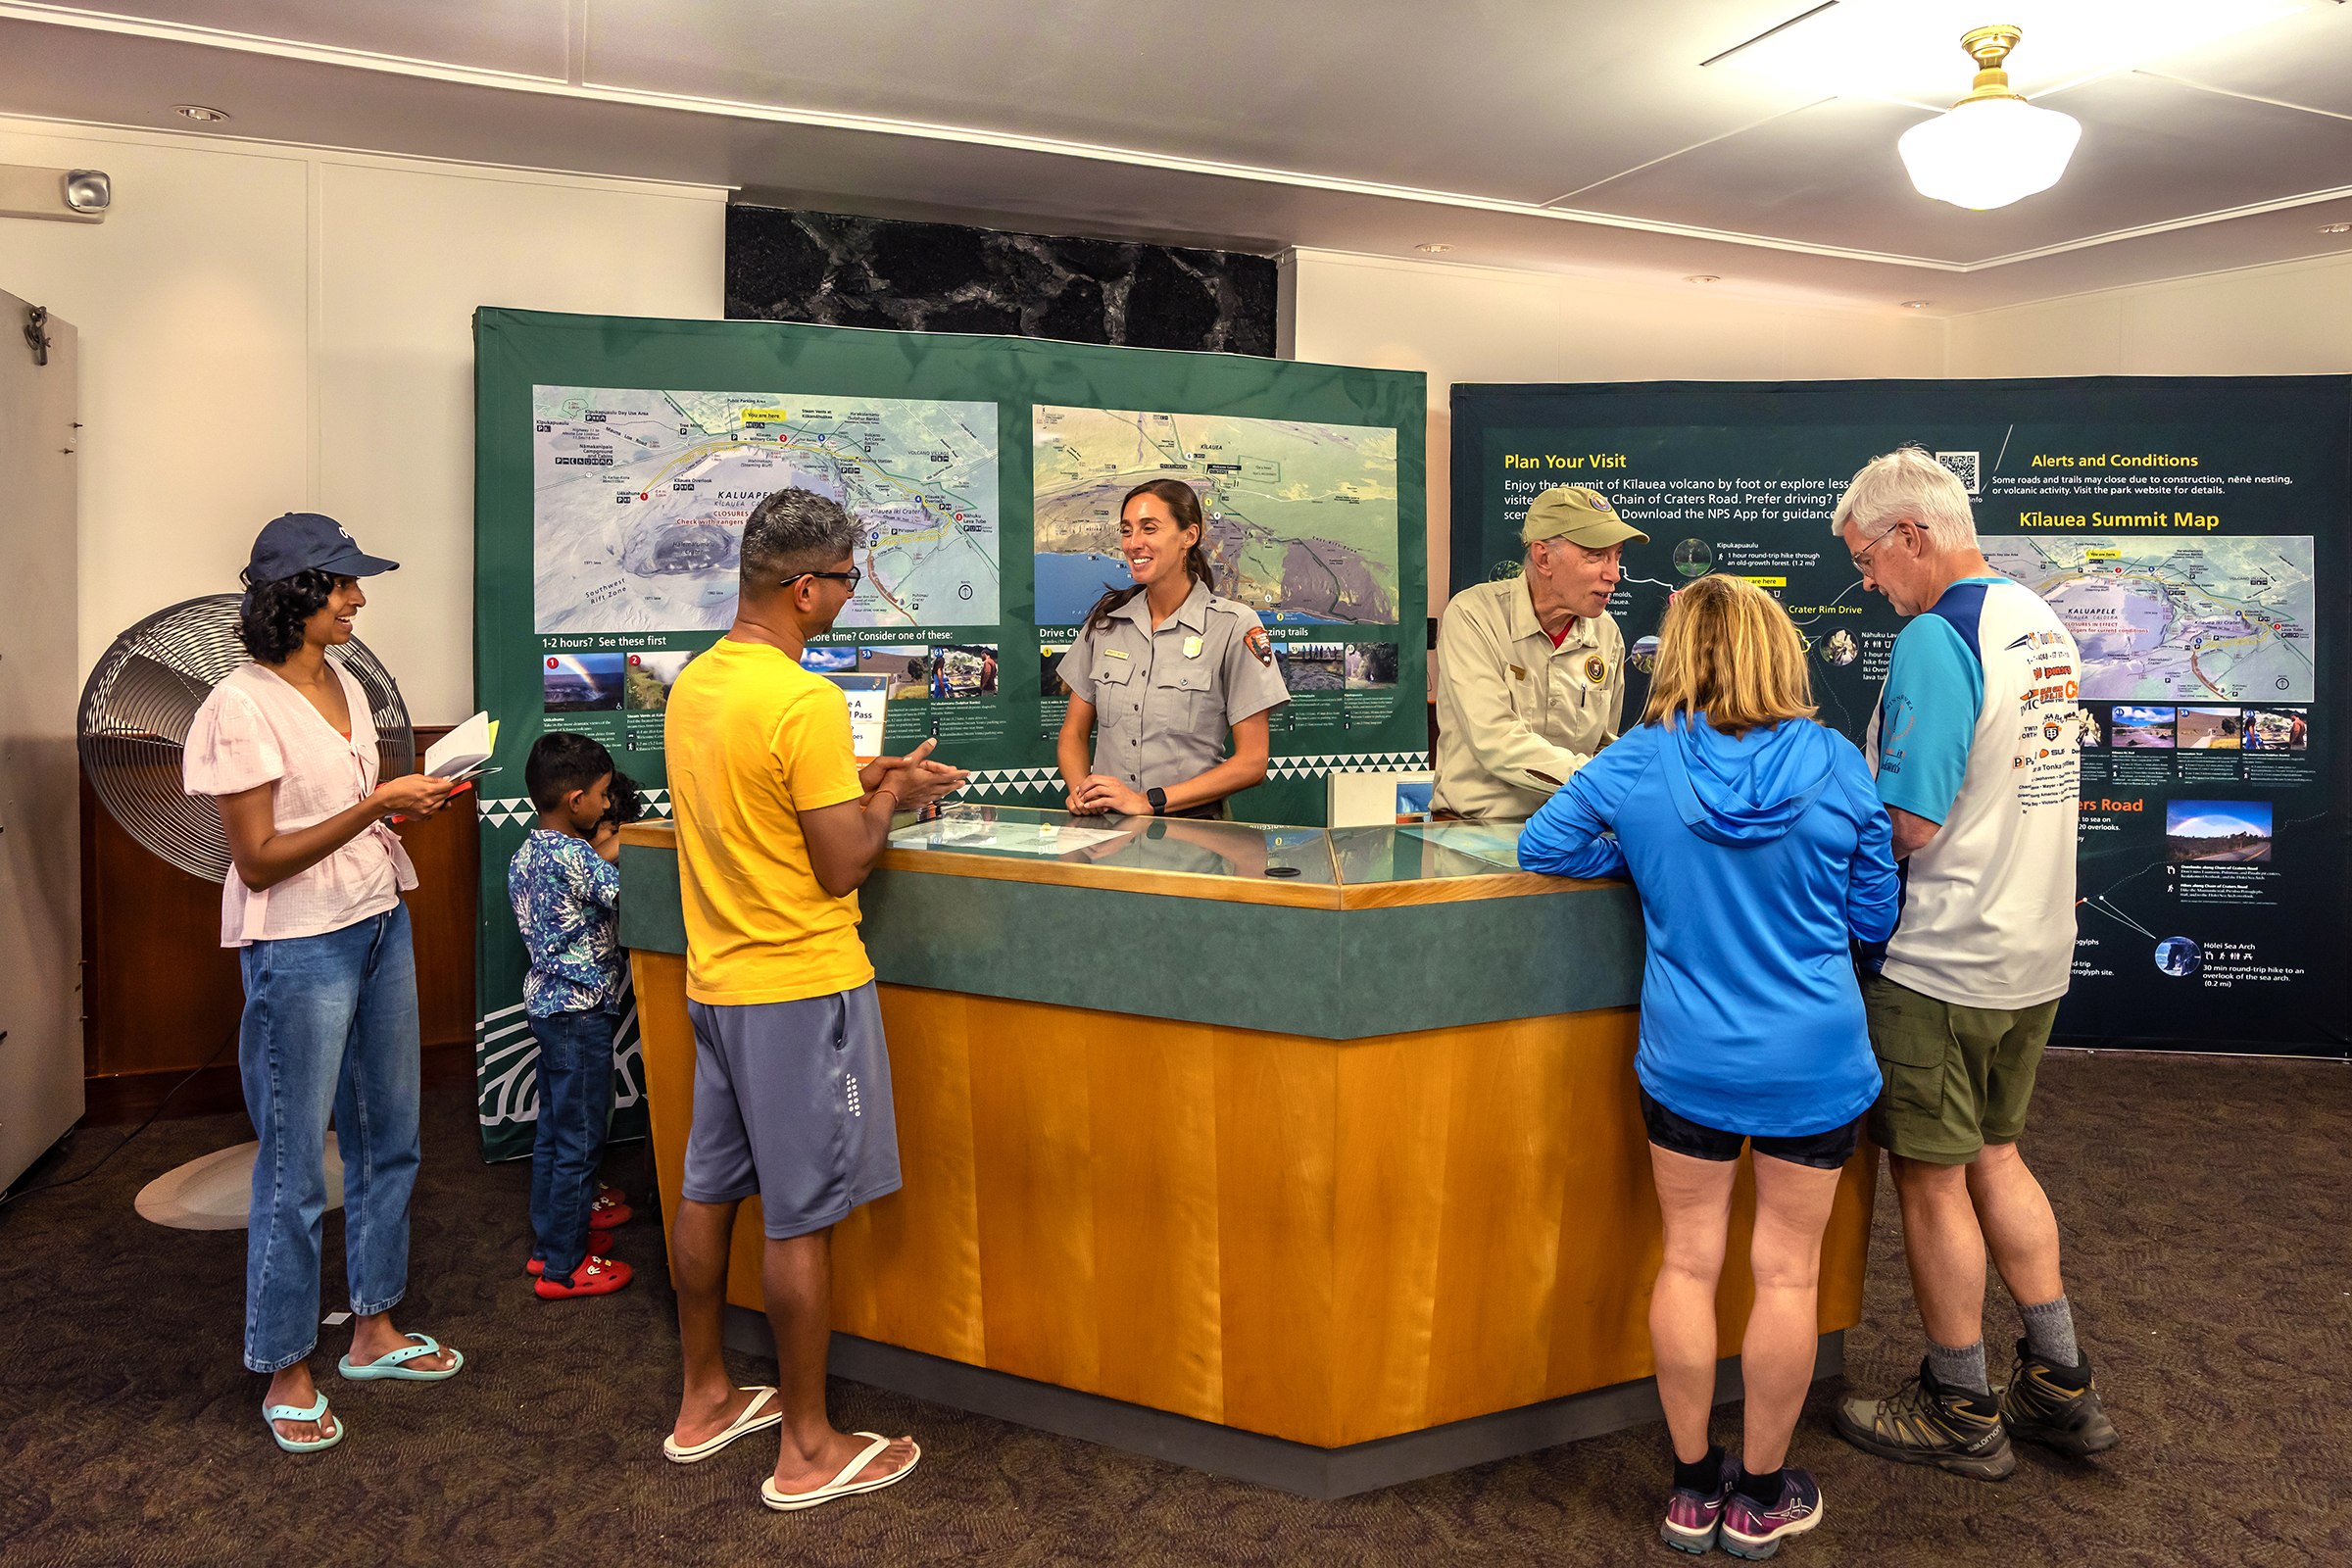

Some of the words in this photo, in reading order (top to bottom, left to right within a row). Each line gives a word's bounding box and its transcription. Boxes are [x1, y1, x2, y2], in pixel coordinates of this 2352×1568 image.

[1504, 454, 1541, 469] Plan
[1544, 454, 1586, 469] Your
[1590, 454, 1627, 469] Visit
[2031, 454, 2075, 468] Alerts
[2078, 454, 2106, 468] and
[2110, 454, 2199, 468] Conditions
[1504, 479, 1537, 493] Enjoy
[1539, 479, 1558, 490] the
[1607, 478, 1620, 490] of
[1669, 478, 1715, 490] volcano
[1718, 478, 1732, 493] by
[1735, 478, 1761, 489] foot
[1764, 481, 1777, 489] or
[1780, 478, 1825, 492] explore
[2084, 477, 2103, 487] may
[2162, 476, 2225, 485] construction,
[2254, 476, 2293, 486] nesting,
[2004, 487, 2037, 495] volcanic
[2039, 487, 2072, 496] activity.
[2073, 487, 2092, 495] Visit
[2094, 487, 2109, 495] the
[2110, 486, 2132, 496] park
[2134, 487, 2172, 495] website
[2174, 486, 2188, 494] for
[2191, 486, 2226, 494] details.
[1503, 494, 1537, 505] visite
[1612, 494, 1645, 505] Chain
[1648, 493, 1661, 505] of
[1664, 494, 1706, 505] Craters
[1709, 494, 1742, 505] Road.
[1746, 493, 1781, 505] Prefer
[1784, 493, 1833, 507] driving?
[1621, 509, 1681, 519] Download
[1684, 509, 1705, 519] the
[1708, 509, 1730, 519] NPS
[1733, 509, 1758, 522] App
[1762, 508, 1779, 519] for
[2091, 512, 2169, 528] Summit
[2174, 512, 2220, 531] Map
[1736, 560, 1771, 568] old-growth
[1792, 560, 1804, 568] (1.2
[1805, 560, 1815, 568] mi)
[585, 577, 626, 598] Southwest
[590, 593, 607, 605] Rift
[608, 586, 628, 598] Zone
[1788, 605, 1817, 614] Crater
[1819, 605, 1837, 614] Rim
[1838, 605, 1863, 614] Drive
[832, 631, 857, 642] time?
[858, 631, 896, 641] Consider
[916, 630, 926, 640] of
[927, 630, 954, 639] these:
[1039, 628, 1065, 638] Drive
[1268, 627, 1286, 639] zing
[1288, 627, 1309, 637] trails
[542, 638, 558, 649] 1-2
[560, 637, 594, 648] hours?
[599, 637, 616, 647] See
[618, 636, 645, 646] these
[647, 636, 667, 646] first
[854, 711, 873, 719] Pass
[2101, 798, 2144, 812] Road
[2229, 965, 2267, 975] round-trip
